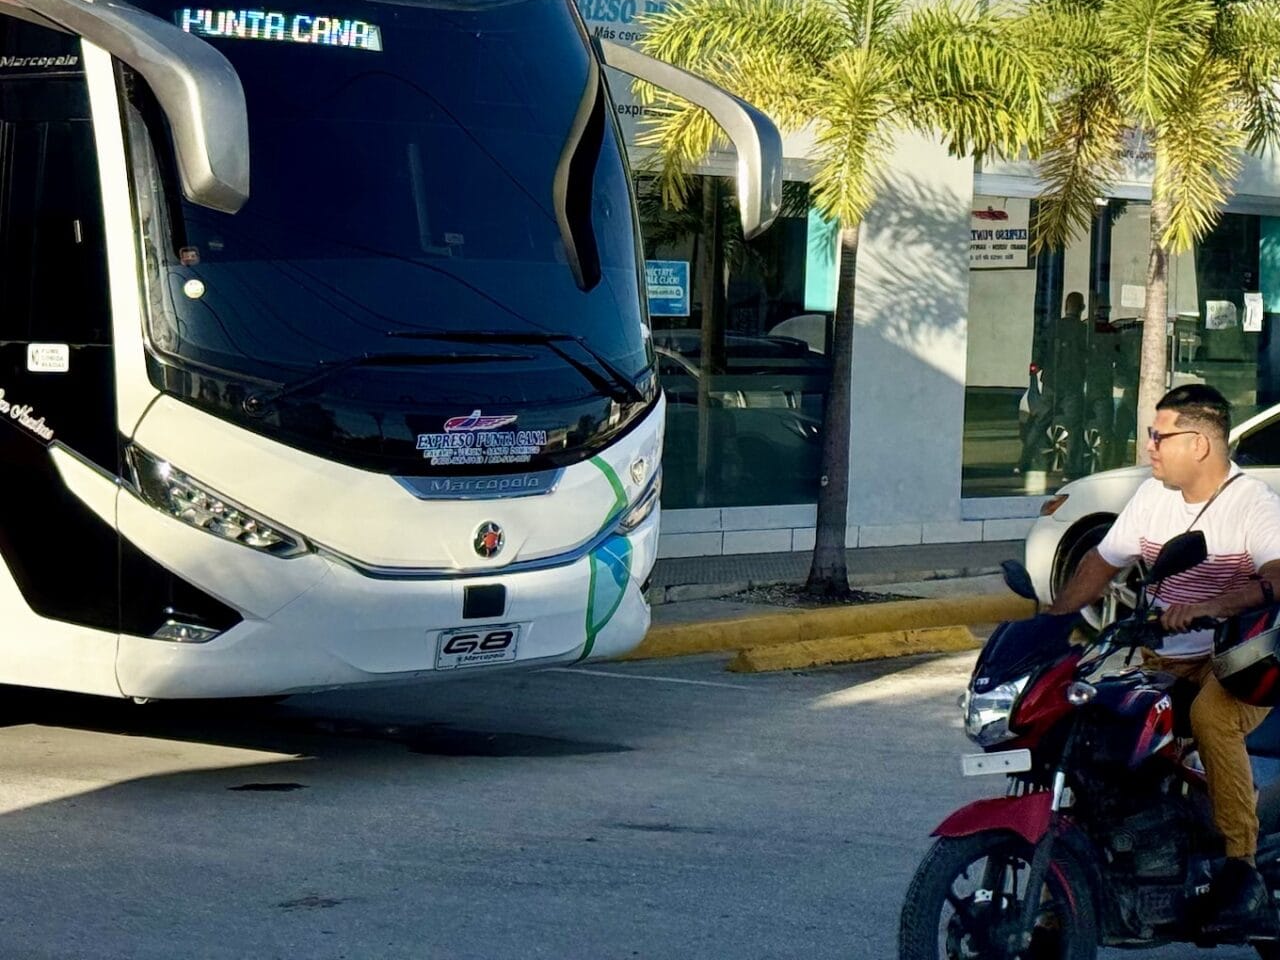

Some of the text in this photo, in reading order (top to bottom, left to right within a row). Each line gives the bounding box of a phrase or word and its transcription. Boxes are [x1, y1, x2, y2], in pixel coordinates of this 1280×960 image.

[292, 14, 369, 48] CANA
[416, 430, 548, 449] EXPRESO PUNTA CANA
[430, 475, 540, 491] Marcopolo
[443, 631, 513, 654] G8
